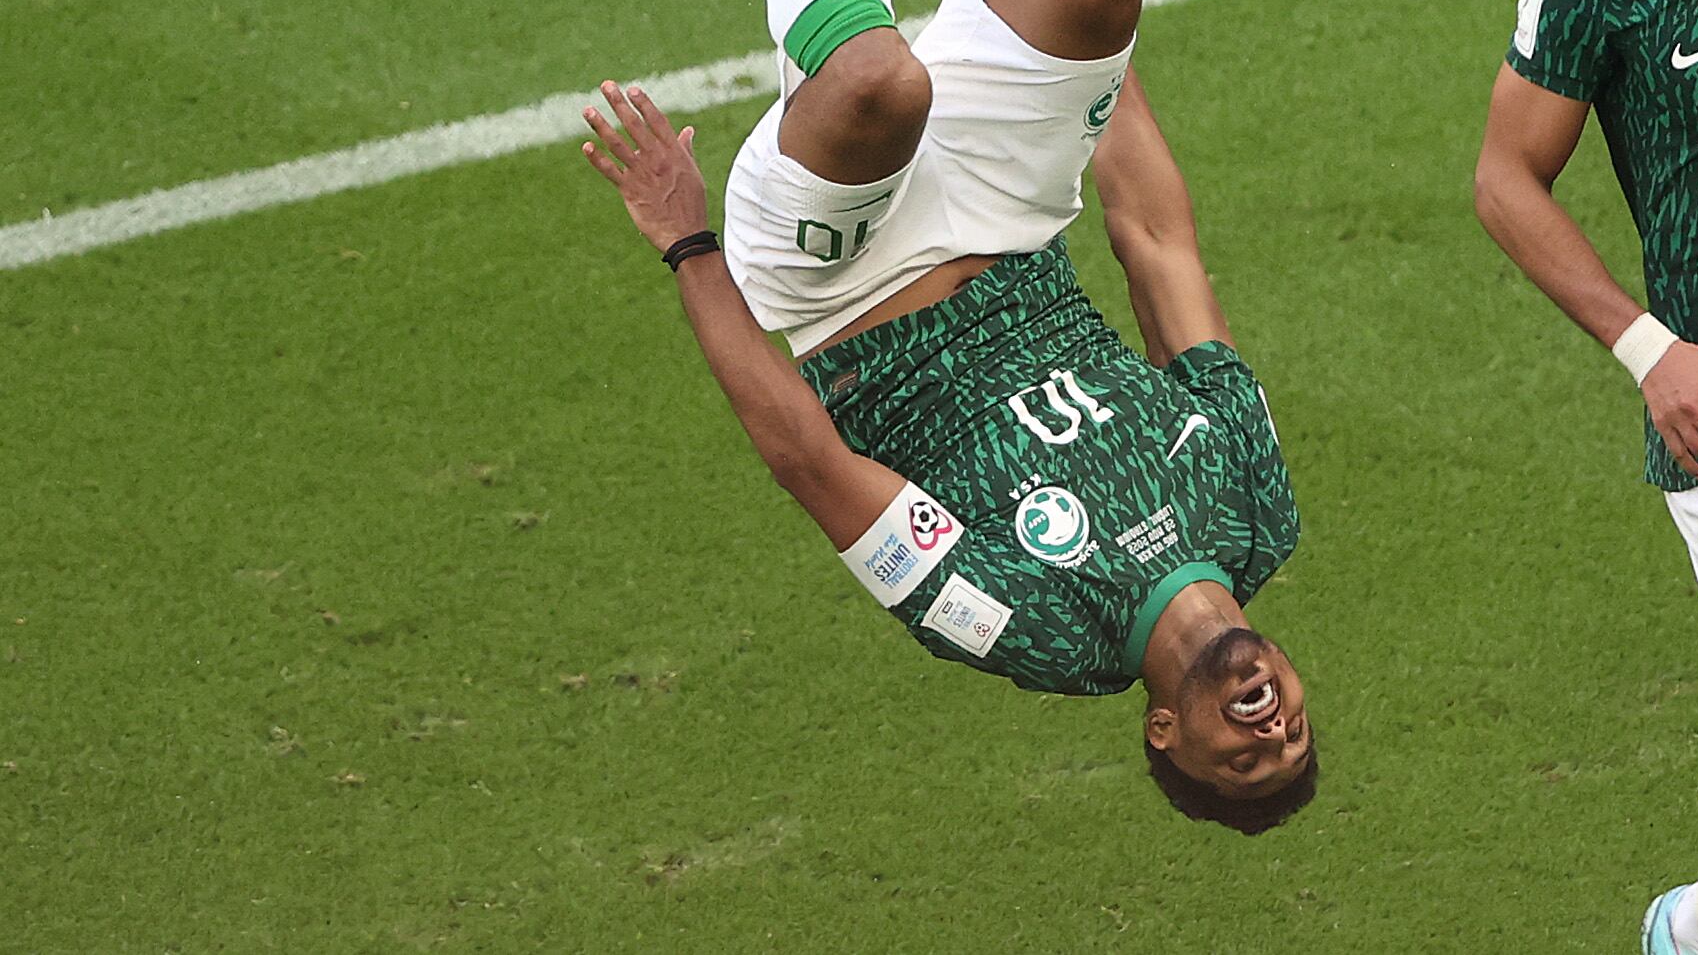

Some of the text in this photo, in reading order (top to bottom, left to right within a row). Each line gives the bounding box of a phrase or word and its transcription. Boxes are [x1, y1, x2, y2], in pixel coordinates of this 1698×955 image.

[797, 219, 869, 263] 10
[1008, 368, 1115, 445] 10
[1008, 472, 1042, 501] KSA
[1162, 518, 1177, 532] 22
[873, 542, 911, 582] UNITES
[1126, 535, 1150, 555] 2022
[884, 553, 919, 589] FOOTBALL
